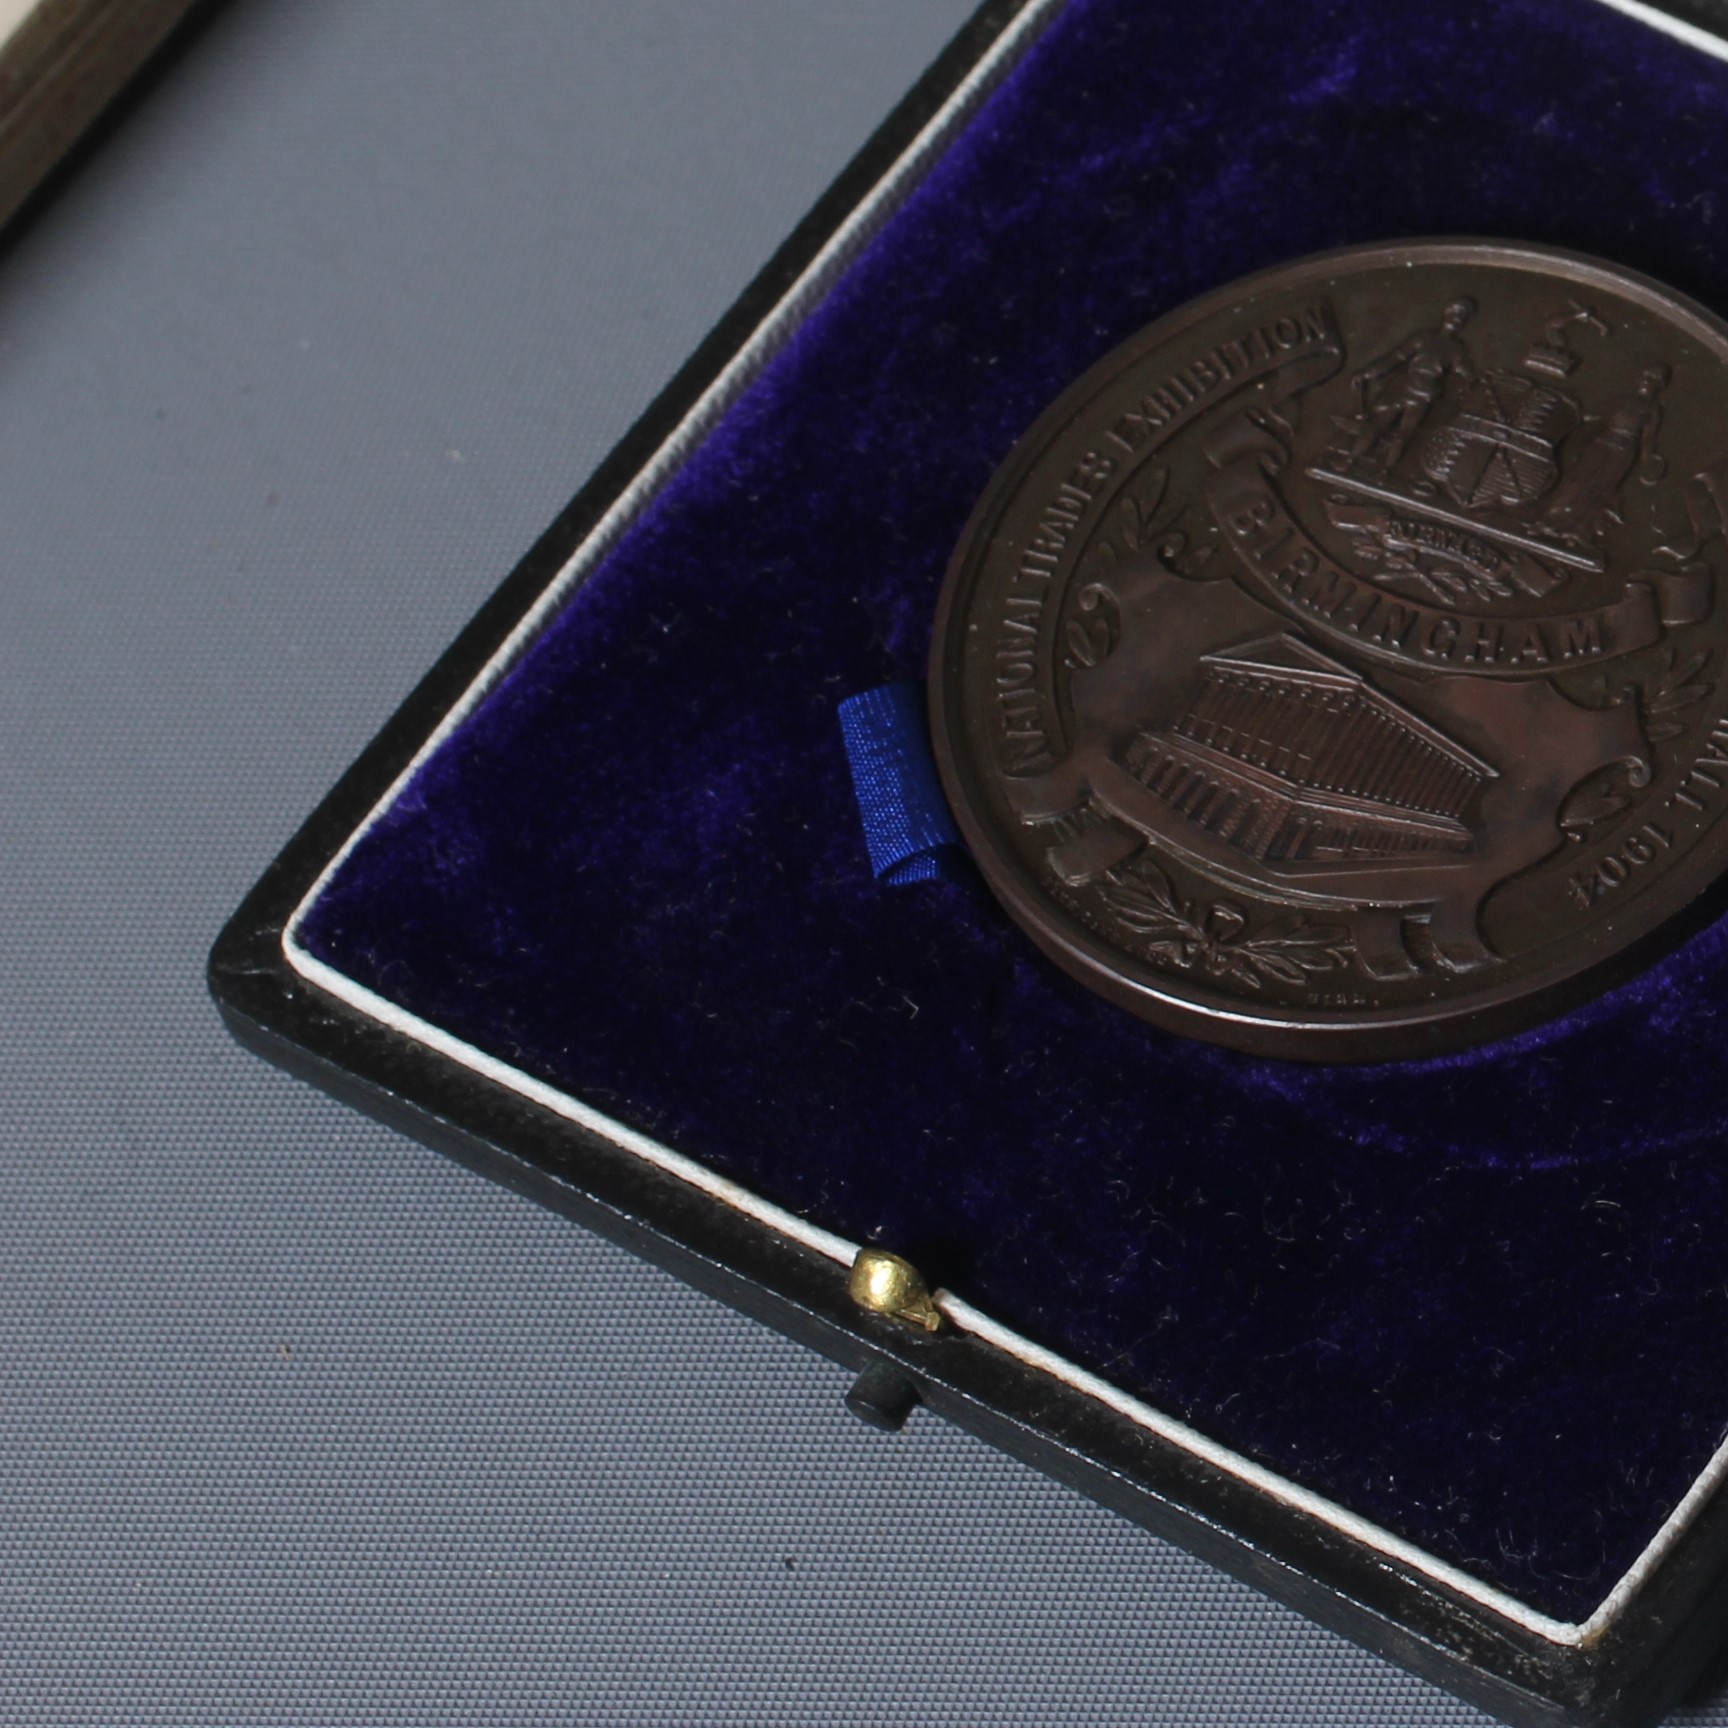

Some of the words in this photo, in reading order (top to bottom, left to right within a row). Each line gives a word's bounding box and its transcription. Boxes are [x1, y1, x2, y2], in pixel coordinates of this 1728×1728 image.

[1012, 450, 1112, 578] TRADES
[1104, 302, 1330, 454] EXHIBITION
[1228, 492, 1602, 664] BIRMINGHAM
